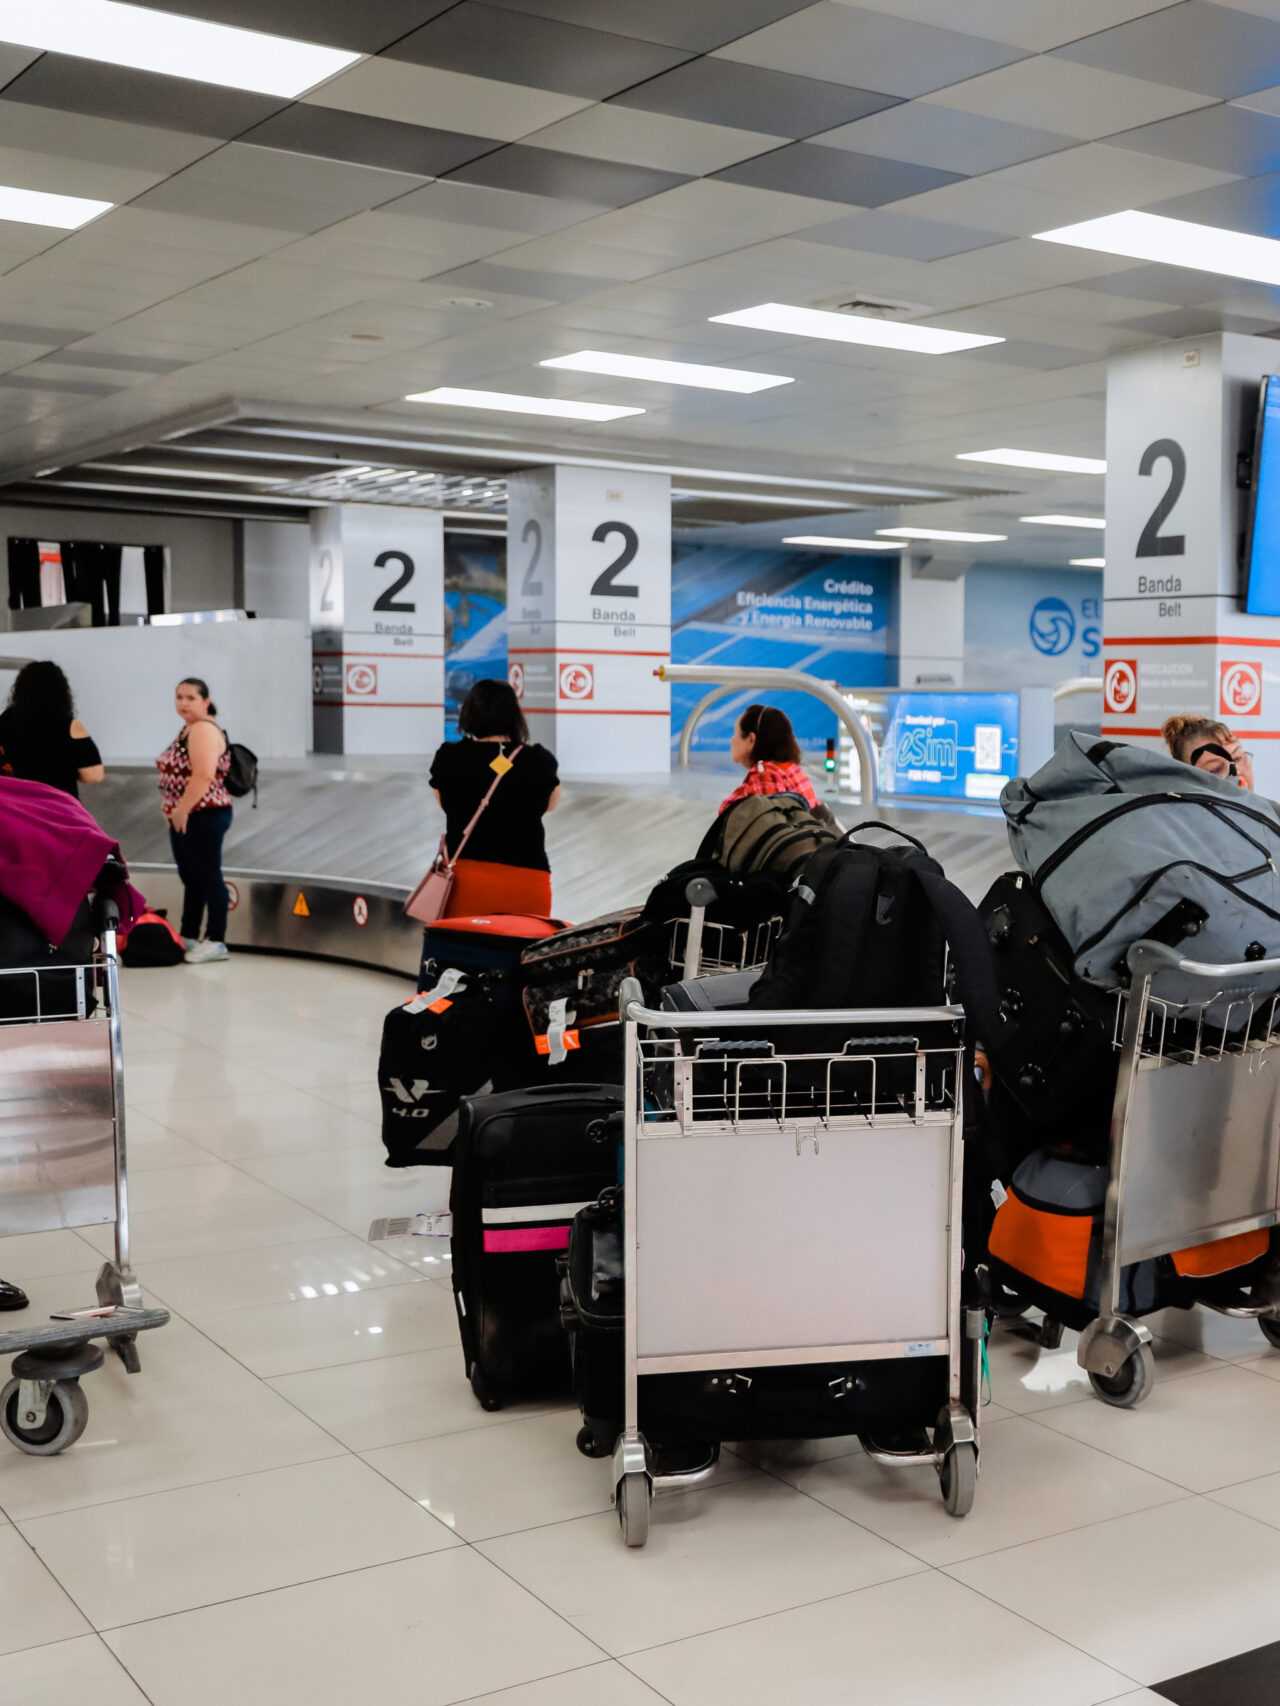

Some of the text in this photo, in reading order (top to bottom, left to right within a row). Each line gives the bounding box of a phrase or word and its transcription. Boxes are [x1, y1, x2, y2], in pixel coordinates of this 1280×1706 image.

[1135, 438, 1187, 558] 2
[522, 519, 543, 597] 2
[590, 520, 640, 598] 2
[372, 550, 416, 613] 2
[823, 578, 874, 595] Crédito
[1138, 575, 1182, 594] Banda
[736, 591, 873, 615] Eficiencia Energética
[1158, 602, 1182, 618] Belt
[592, 608, 636, 622] Banda
[803, 613, 873, 631] Renovable
[375, 622, 414, 635] Banda
[613, 626, 636, 638] Belt
[896, 728, 956, 768] eSim
[392, 1107, 430, 1118] 4.0
